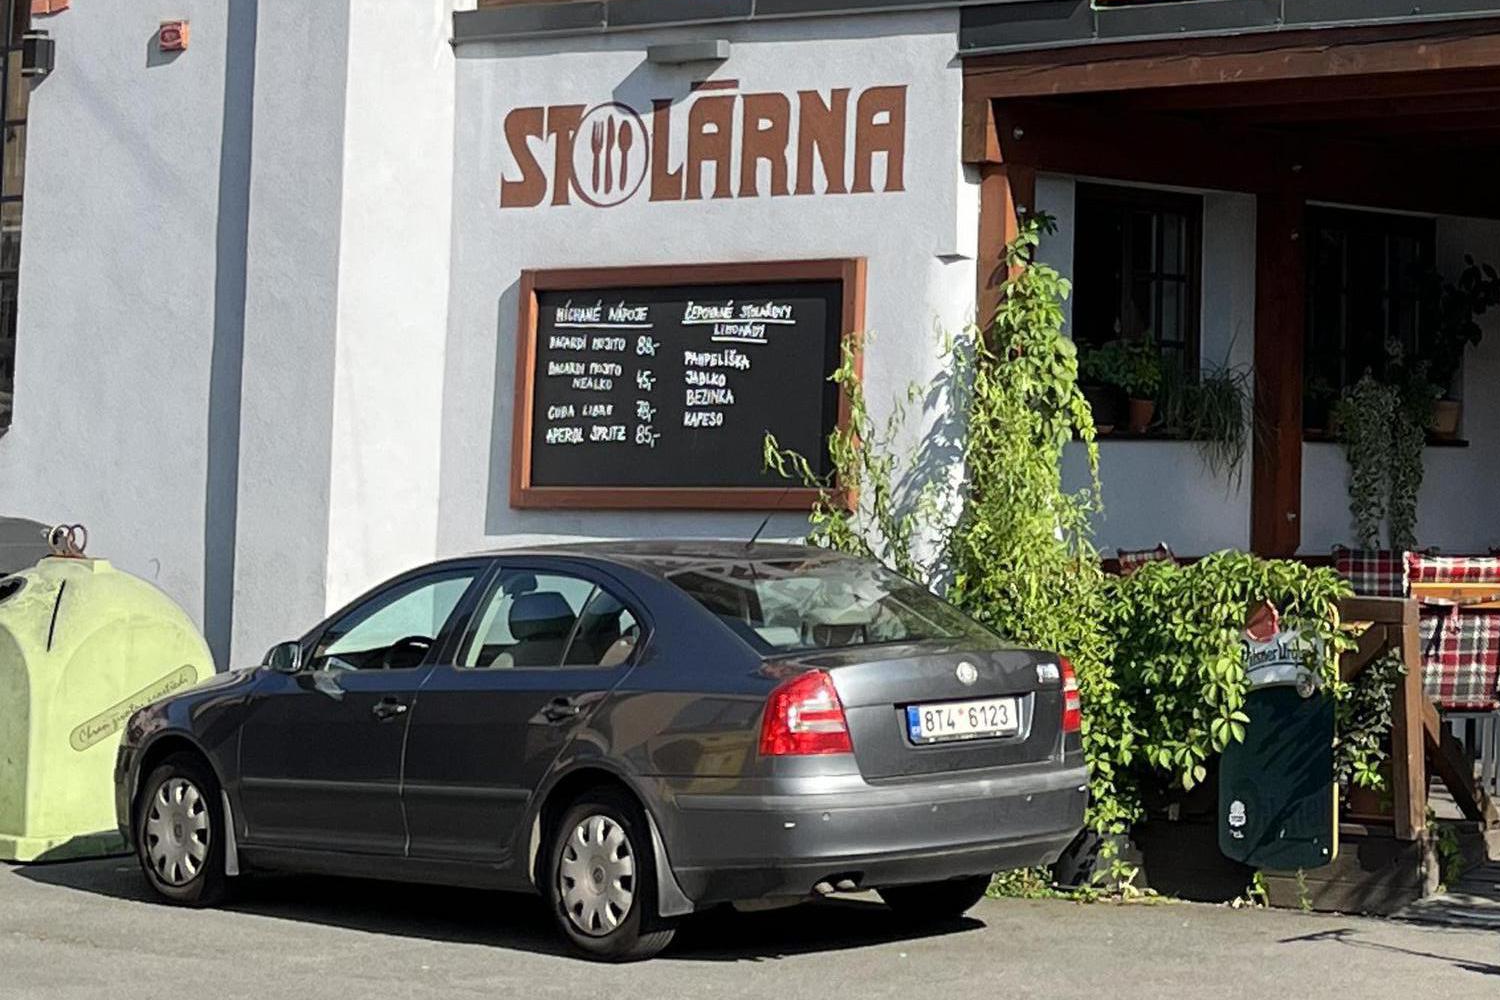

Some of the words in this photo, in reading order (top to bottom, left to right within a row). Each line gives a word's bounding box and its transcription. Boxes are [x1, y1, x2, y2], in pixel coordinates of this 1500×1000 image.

[500, 80, 908, 209] STOLÁRNA
[924, 708, 956, 733] 8T4
[967, 704, 1009, 729] 6123
